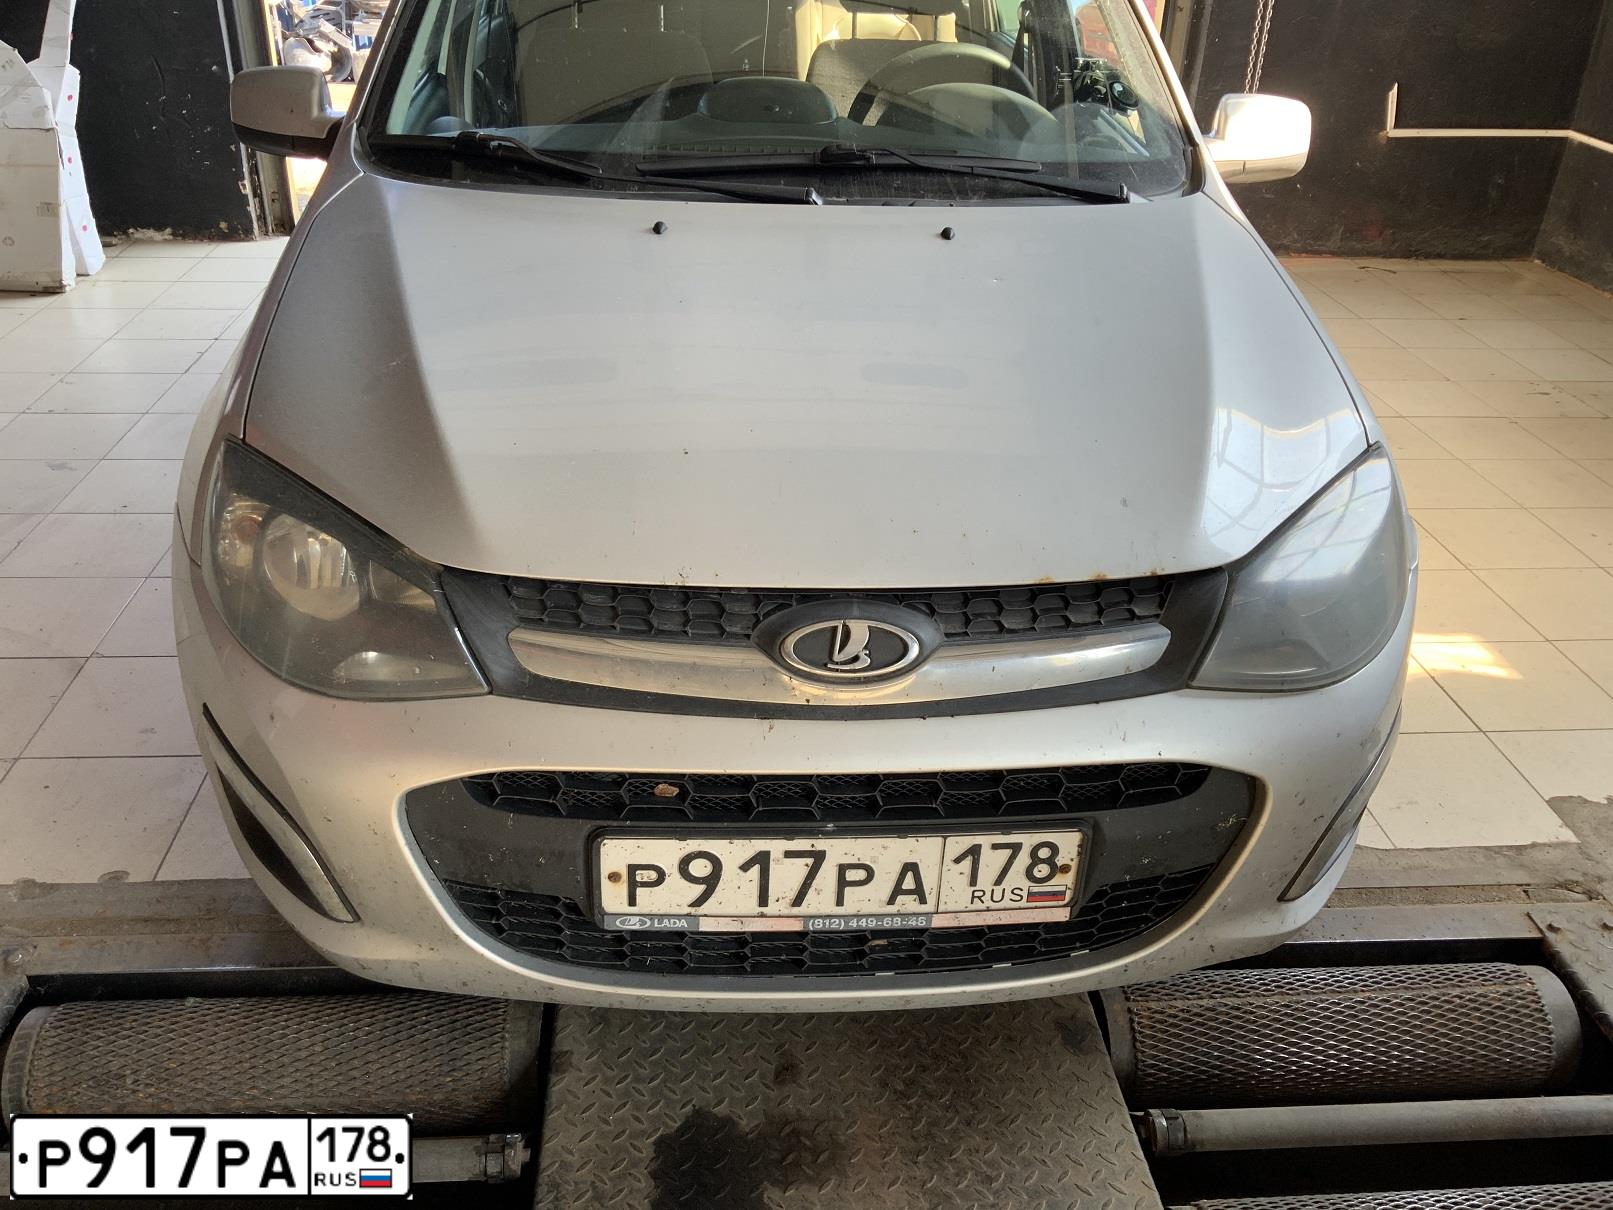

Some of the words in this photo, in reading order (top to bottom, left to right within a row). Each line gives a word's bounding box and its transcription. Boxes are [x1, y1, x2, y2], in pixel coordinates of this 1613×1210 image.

[952, 841, 1060, 887] 178
[970, 887, 1024, 904] RUS
[654, 918, 688, 928] LADA
[808, 918, 845, 930] (812)
